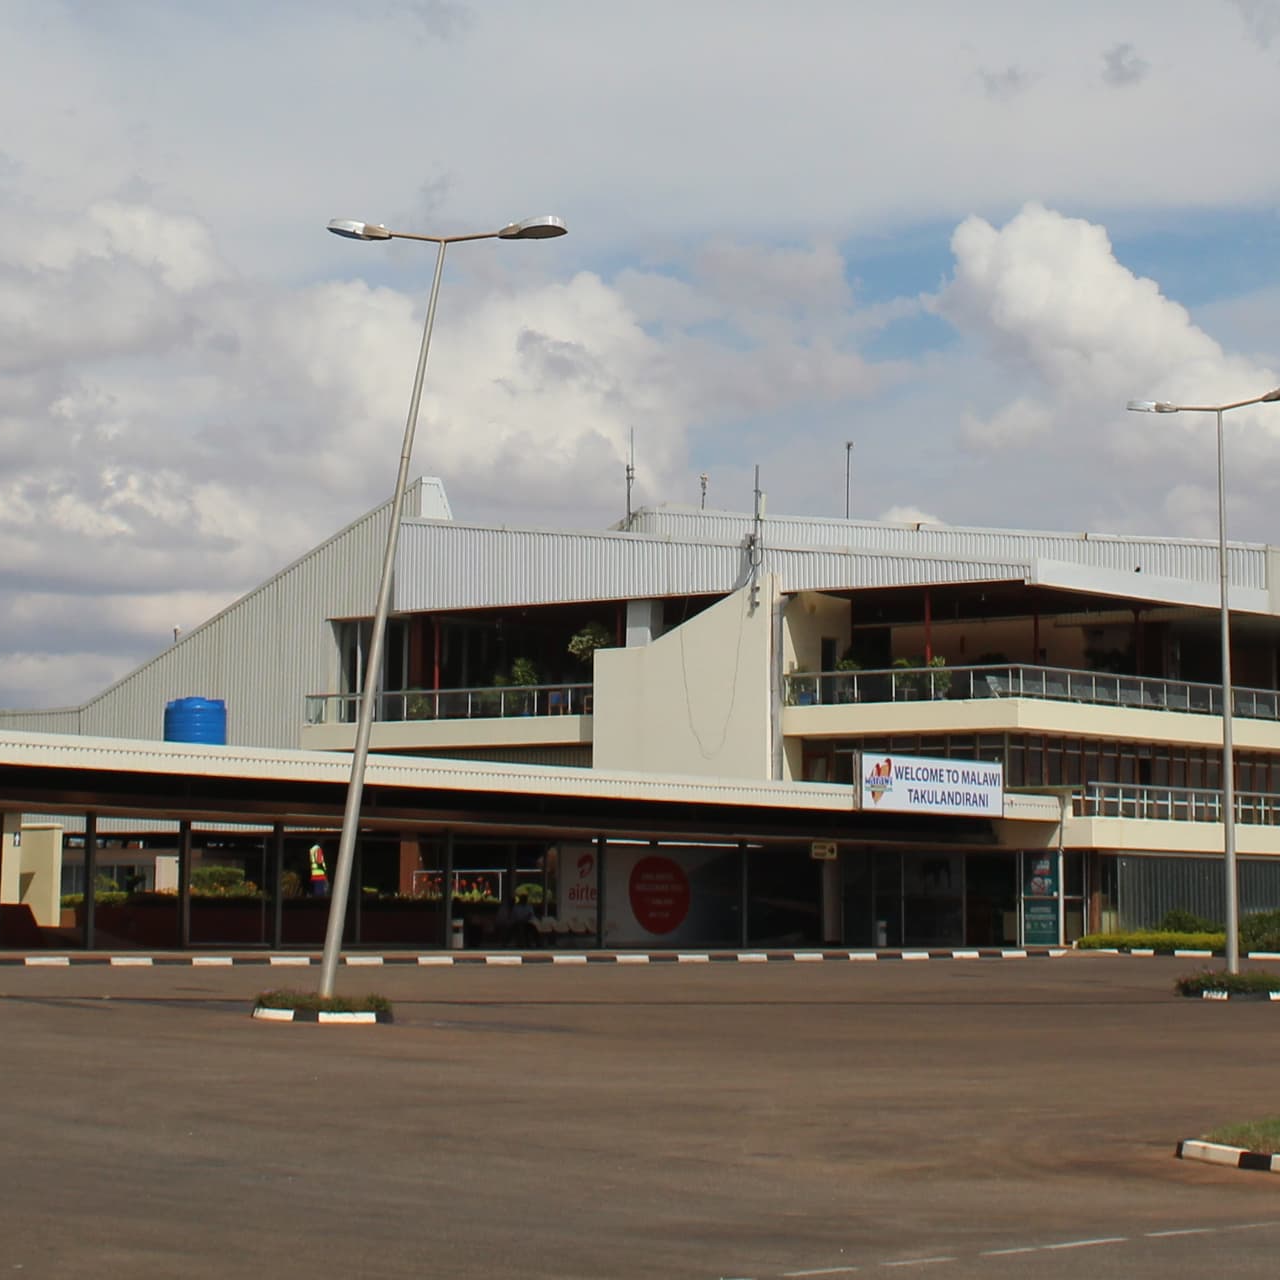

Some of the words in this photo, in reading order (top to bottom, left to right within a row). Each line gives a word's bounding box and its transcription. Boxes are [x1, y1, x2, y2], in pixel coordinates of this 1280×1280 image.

[894, 765, 944, 783] WELCOME
[946, 770, 959, 784] TO
[961, 770, 1001, 787] MALAWI
[908, 788, 989, 808] TAKULANDIRANI
[568, 884, 598, 901] airte
